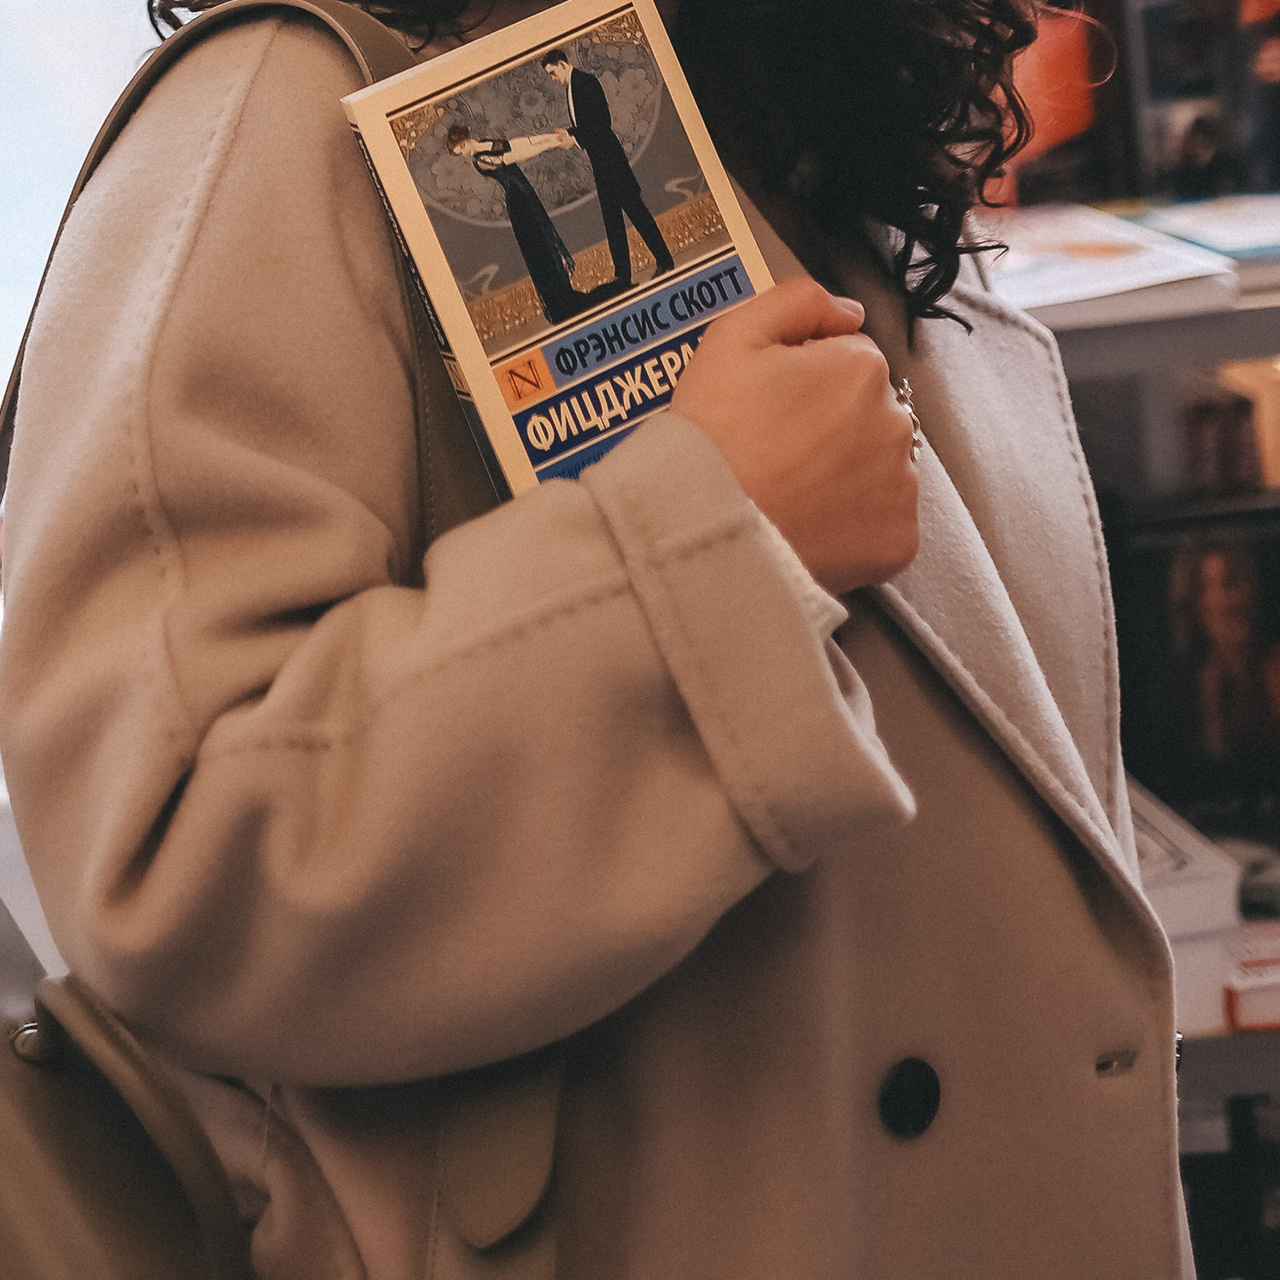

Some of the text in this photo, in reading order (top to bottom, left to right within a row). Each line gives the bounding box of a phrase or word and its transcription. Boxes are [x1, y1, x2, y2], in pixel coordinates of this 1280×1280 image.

[555, 265, 744, 377] ФРЭНСИС СКОТТ
[526, 335, 704, 452] ФИЦДЖЕР
